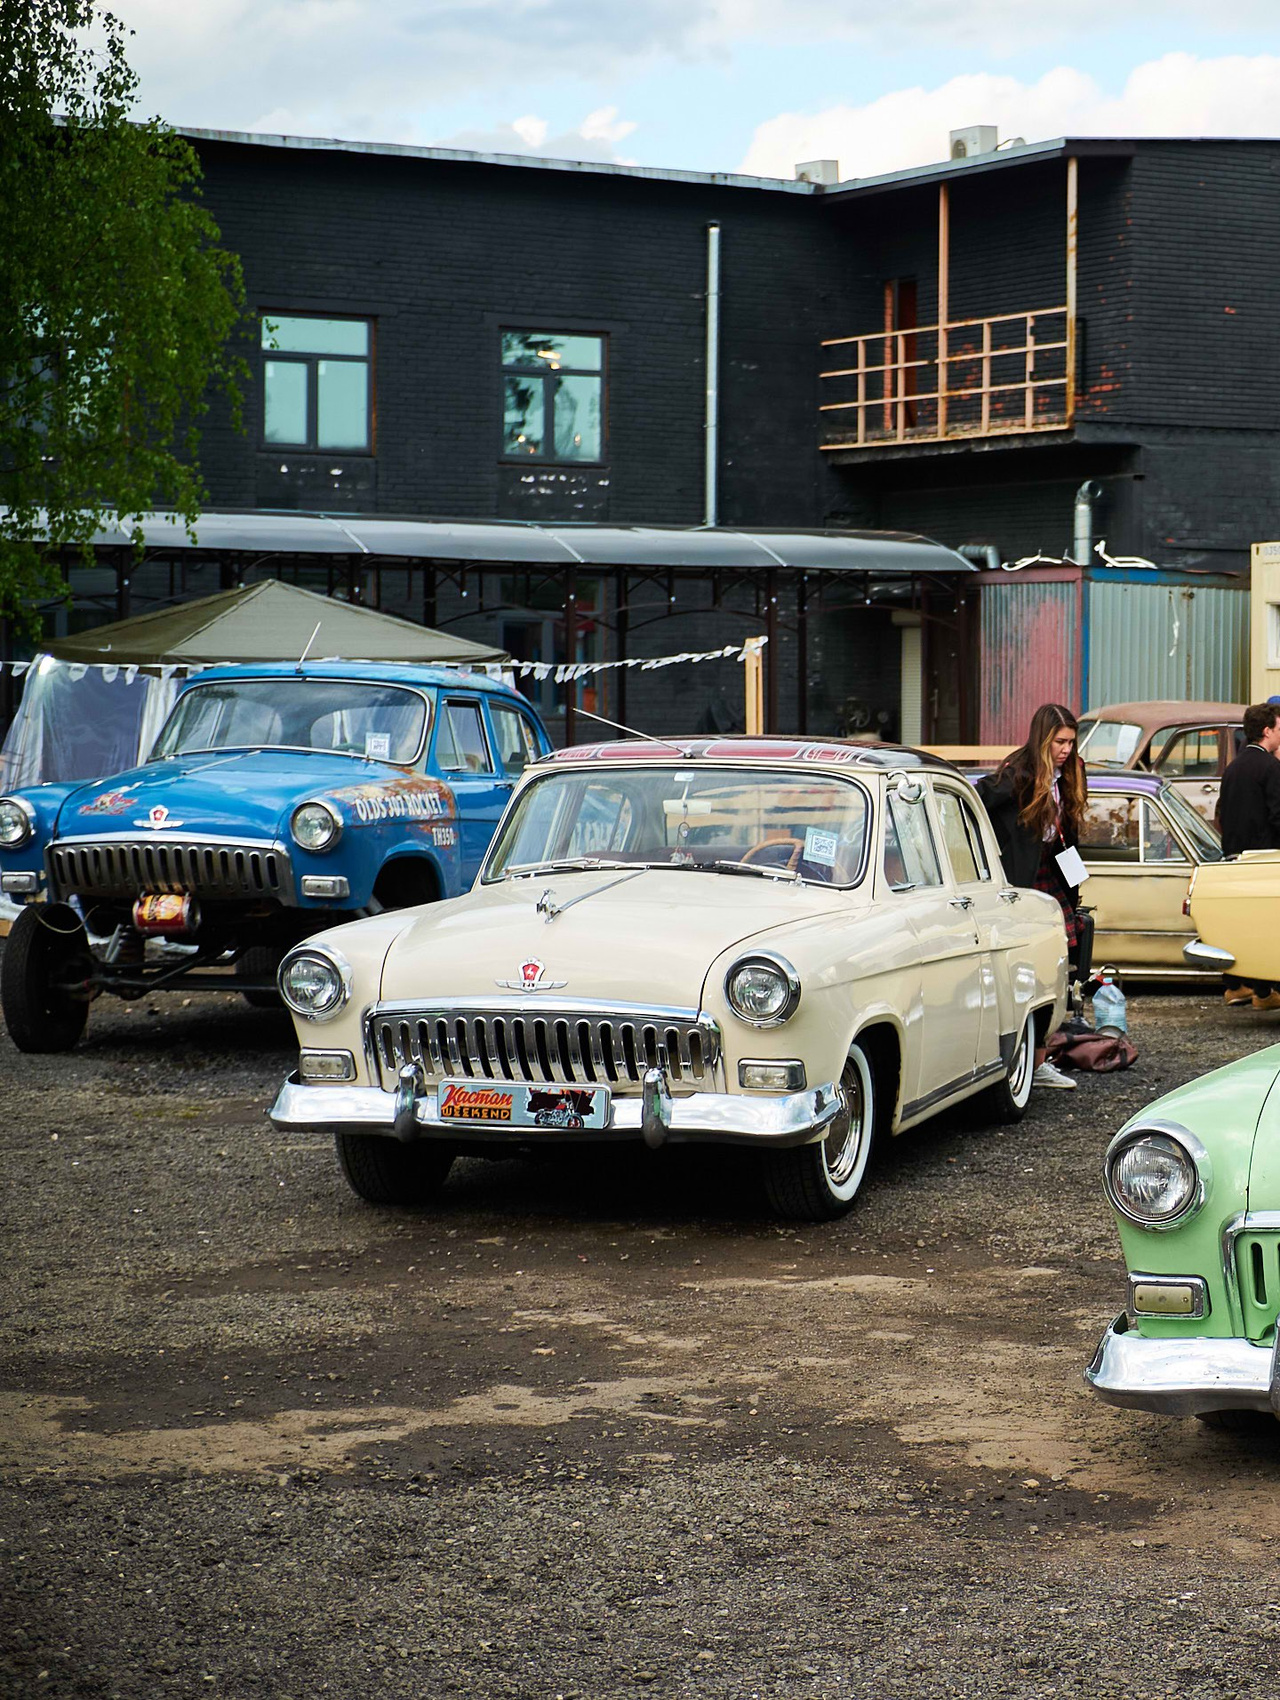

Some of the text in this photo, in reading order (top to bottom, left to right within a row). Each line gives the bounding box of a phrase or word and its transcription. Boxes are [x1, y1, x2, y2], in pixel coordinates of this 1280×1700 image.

[355, 792, 443, 821] OLDS 307 ROCKET
[431, 827, 455, 846] TH350
[441, 1107, 511, 1121] WEEKEND
